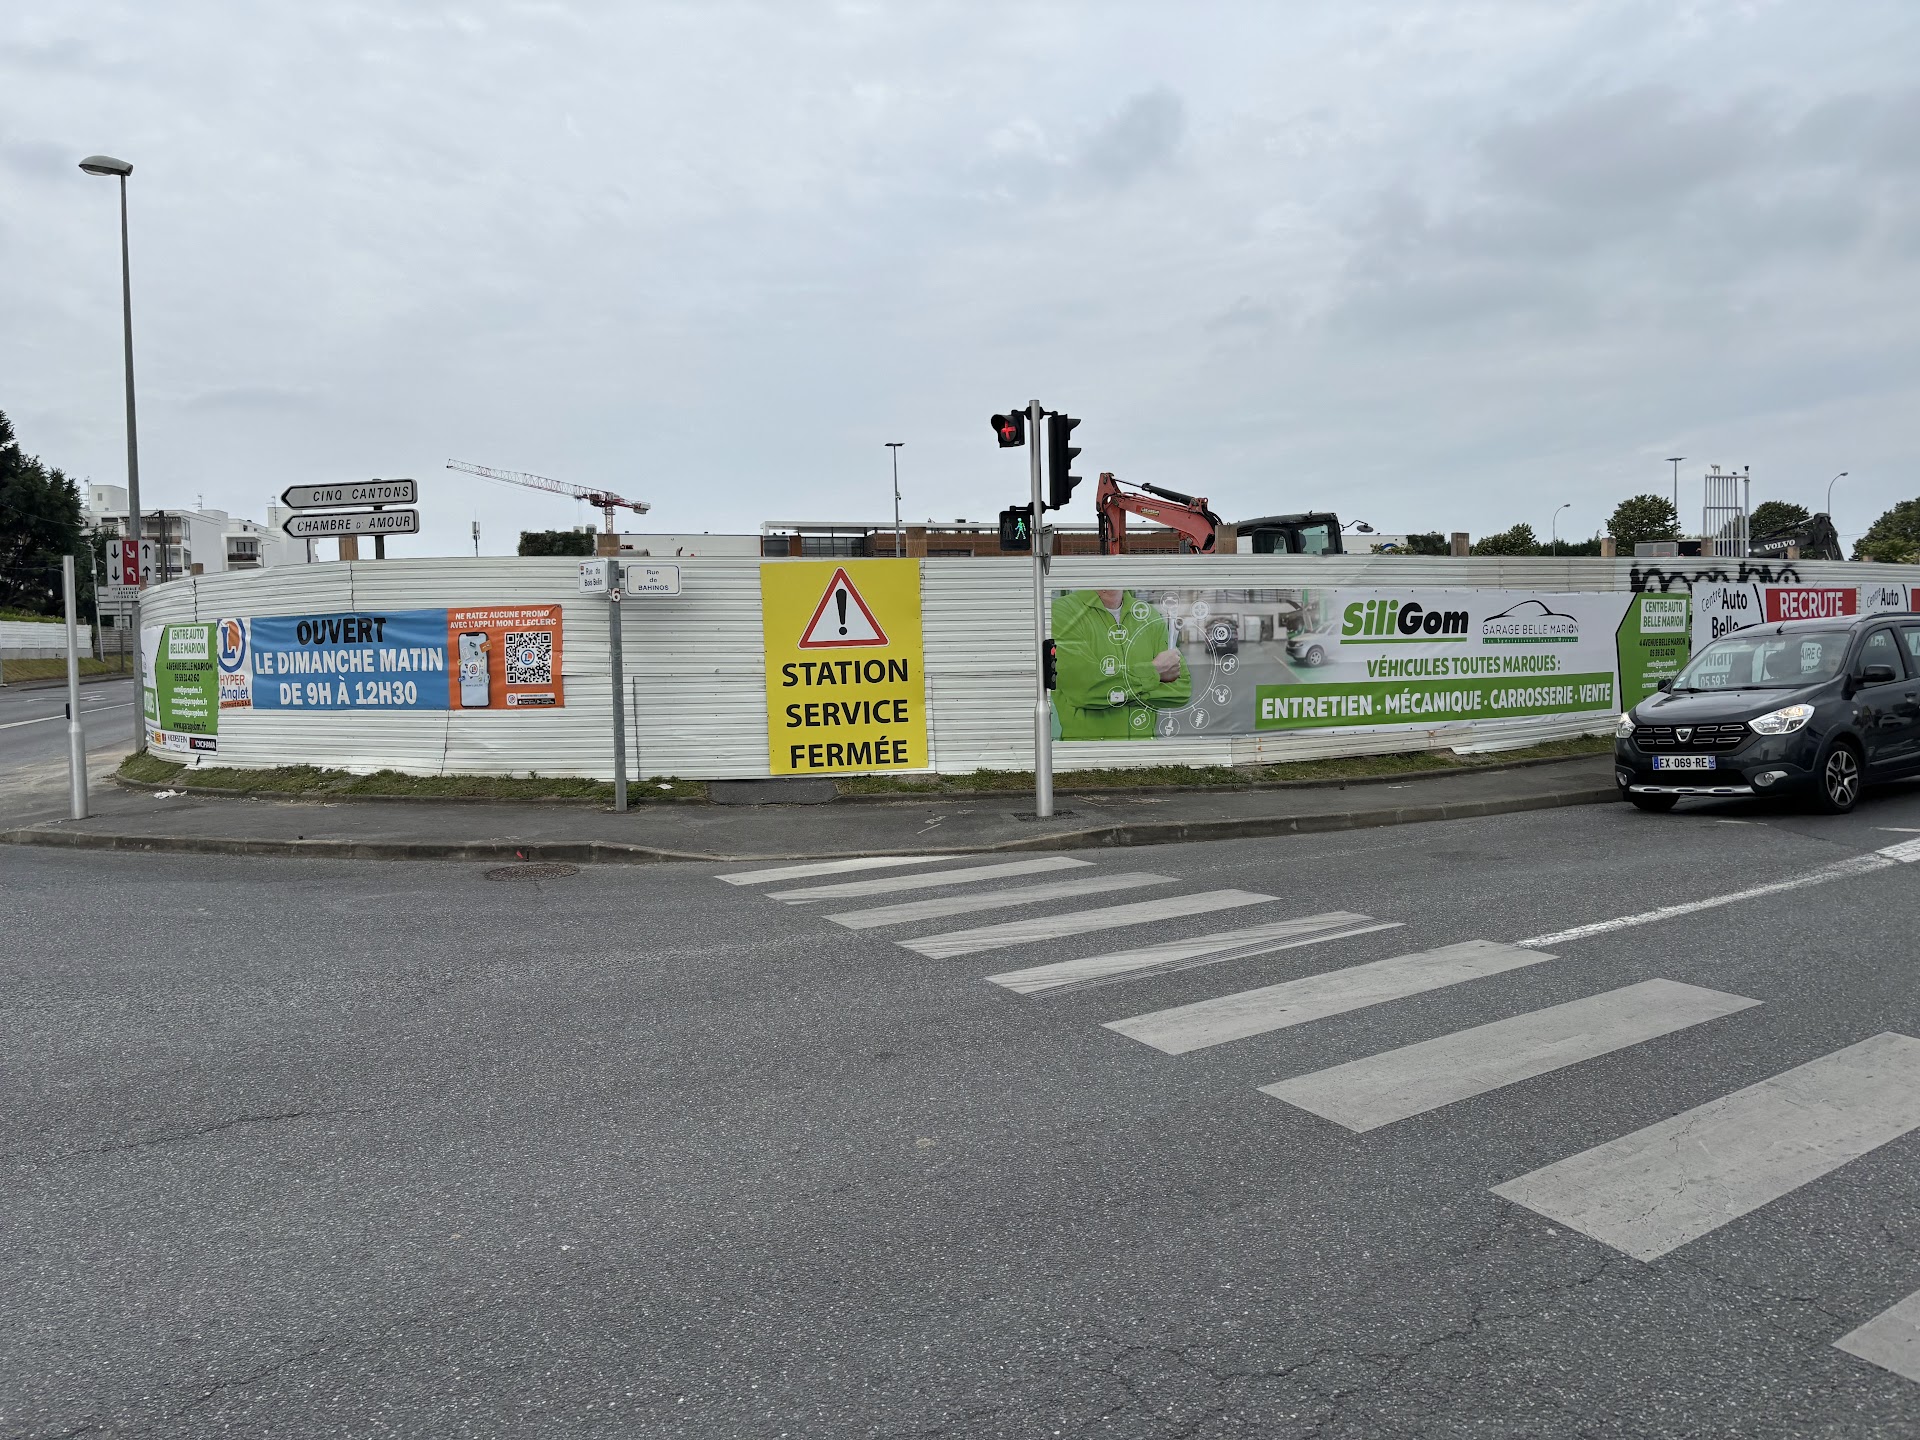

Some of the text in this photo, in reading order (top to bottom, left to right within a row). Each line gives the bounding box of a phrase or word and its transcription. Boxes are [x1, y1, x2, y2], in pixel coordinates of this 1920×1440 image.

[313, 486, 409, 501] CINQ CANTONS
[297, 519, 351, 532] CHAMBRE
[369, 516, 410, 529] AMOUR
[1764, 539, 1795, 550] VOLVO
[1701, 587, 1748, 613] Centre Auto
[1780, 591, 1843, 618] RECRUTE
[1867, 587, 1899, 608] Centre Auto
[490, 610, 519, 619] AUCUNE
[521, 610, 549, 618] PROMO
[1645, 601, 1682, 613] CENTRE AUTO
[469, 620, 494, 628] L'APPLI
[515, 618, 556, 626] E.LECLERC
[1341, 599, 1469, 636] SiliGom
[1643, 615, 1684, 627] BELLE MARION
[171, 628, 205, 640] CENTRE AUTO
[296, 617, 386, 645] OUVERT
[1483, 623, 1579, 635] GARAGE BELLE MARION
[170, 642, 206, 654] BELLE MARION
[1659, 638, 1670, 646] BELLE
[255, 648, 443, 674] LE DIMANCHE MATIN
[1367, 654, 1449, 677] VÉHICULES
[1452, 656, 1500, 674] TOUTES
[782, 658, 908, 687] STATION
[220, 675, 246, 686] HYPER
[221, 686, 249, 700] Anglet
[280, 675, 417, 705] DE 9H À 12H30
[1262, 683, 1610, 719] ENTRETIEN MÉCANIQUE CARROSSERIE VENTE
[786, 699, 909, 728] SERVICE
[790, 735, 908, 769] FERMÉE
[1660, 757, 1708, 768] EX-069-RE
